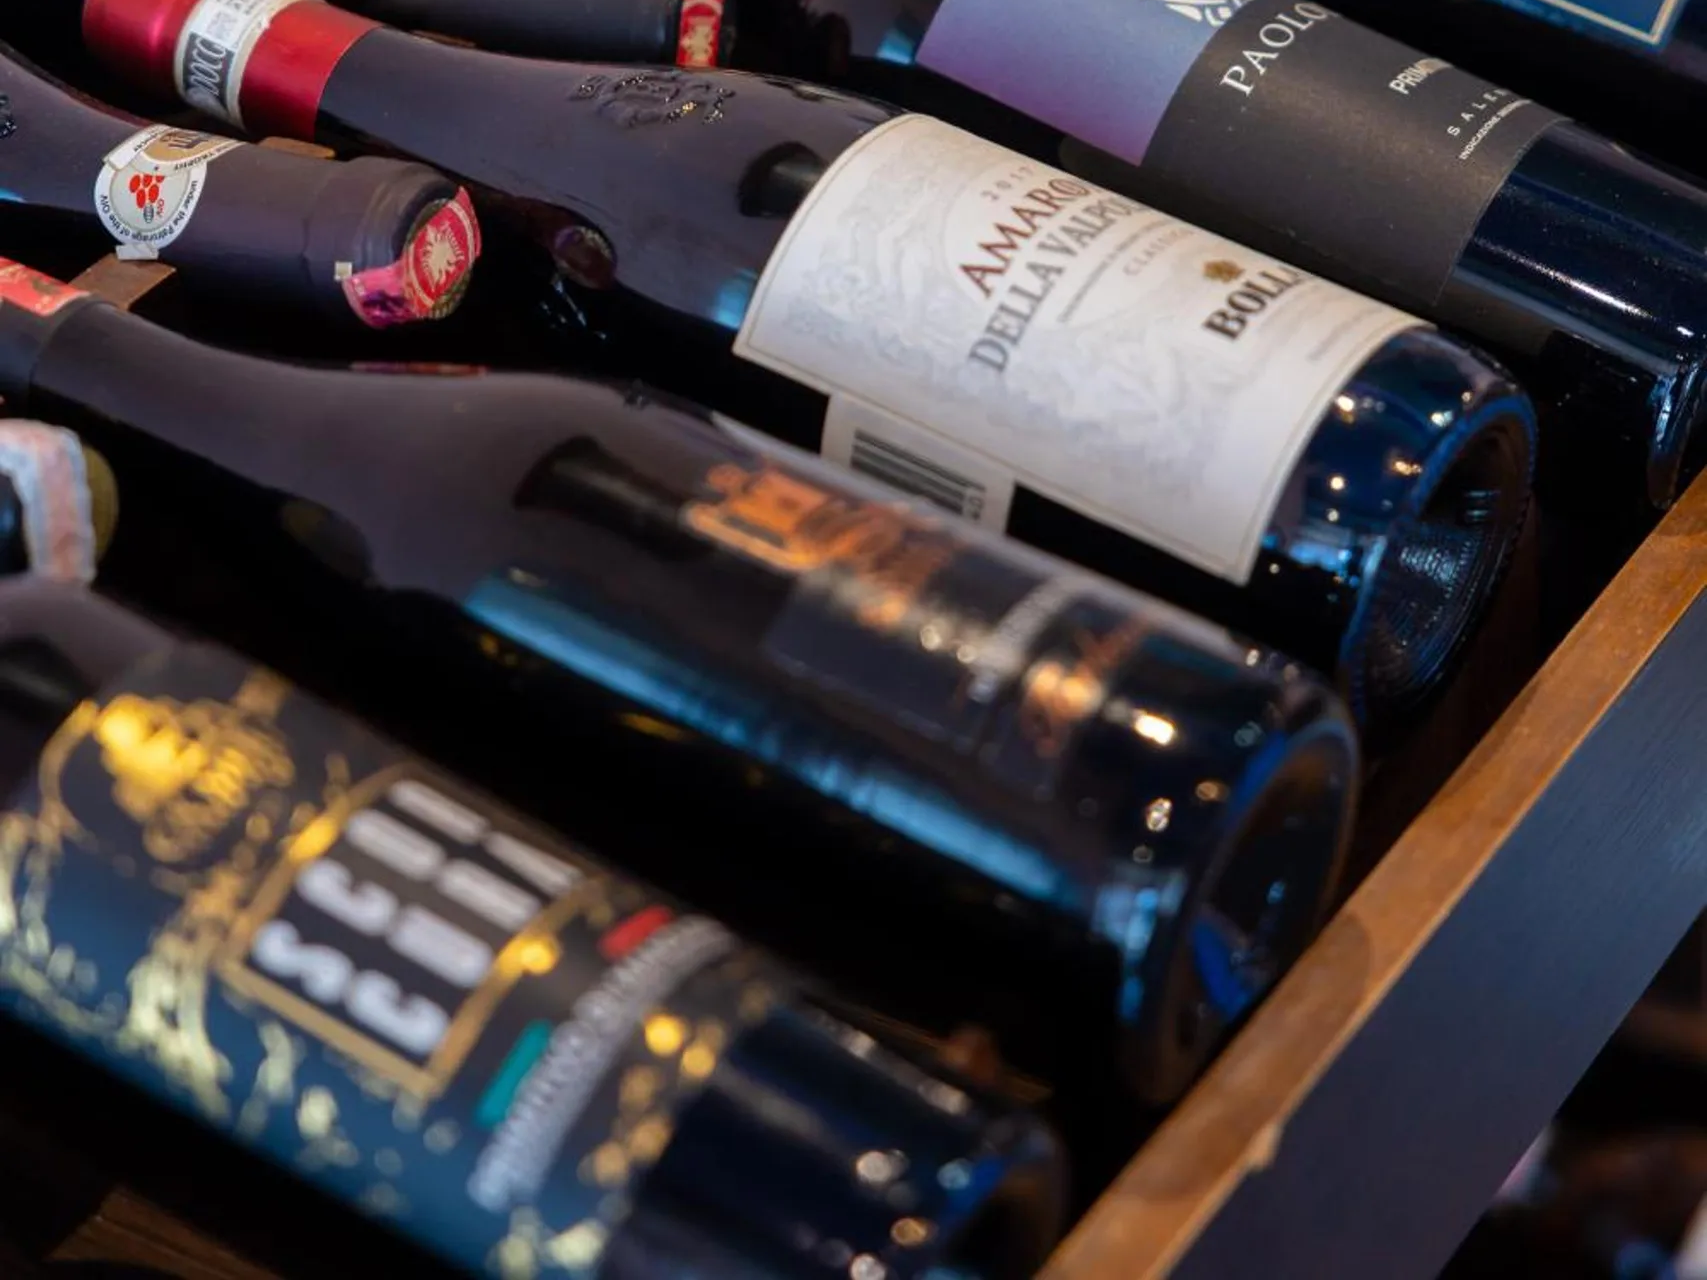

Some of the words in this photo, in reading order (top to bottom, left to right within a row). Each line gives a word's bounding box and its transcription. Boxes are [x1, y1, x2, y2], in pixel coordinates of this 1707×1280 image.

[1220, 2, 1333, 97] PAOLO
[966, 261, 1065, 372] DELLA
[1202, 266, 1306, 342] BOLL
